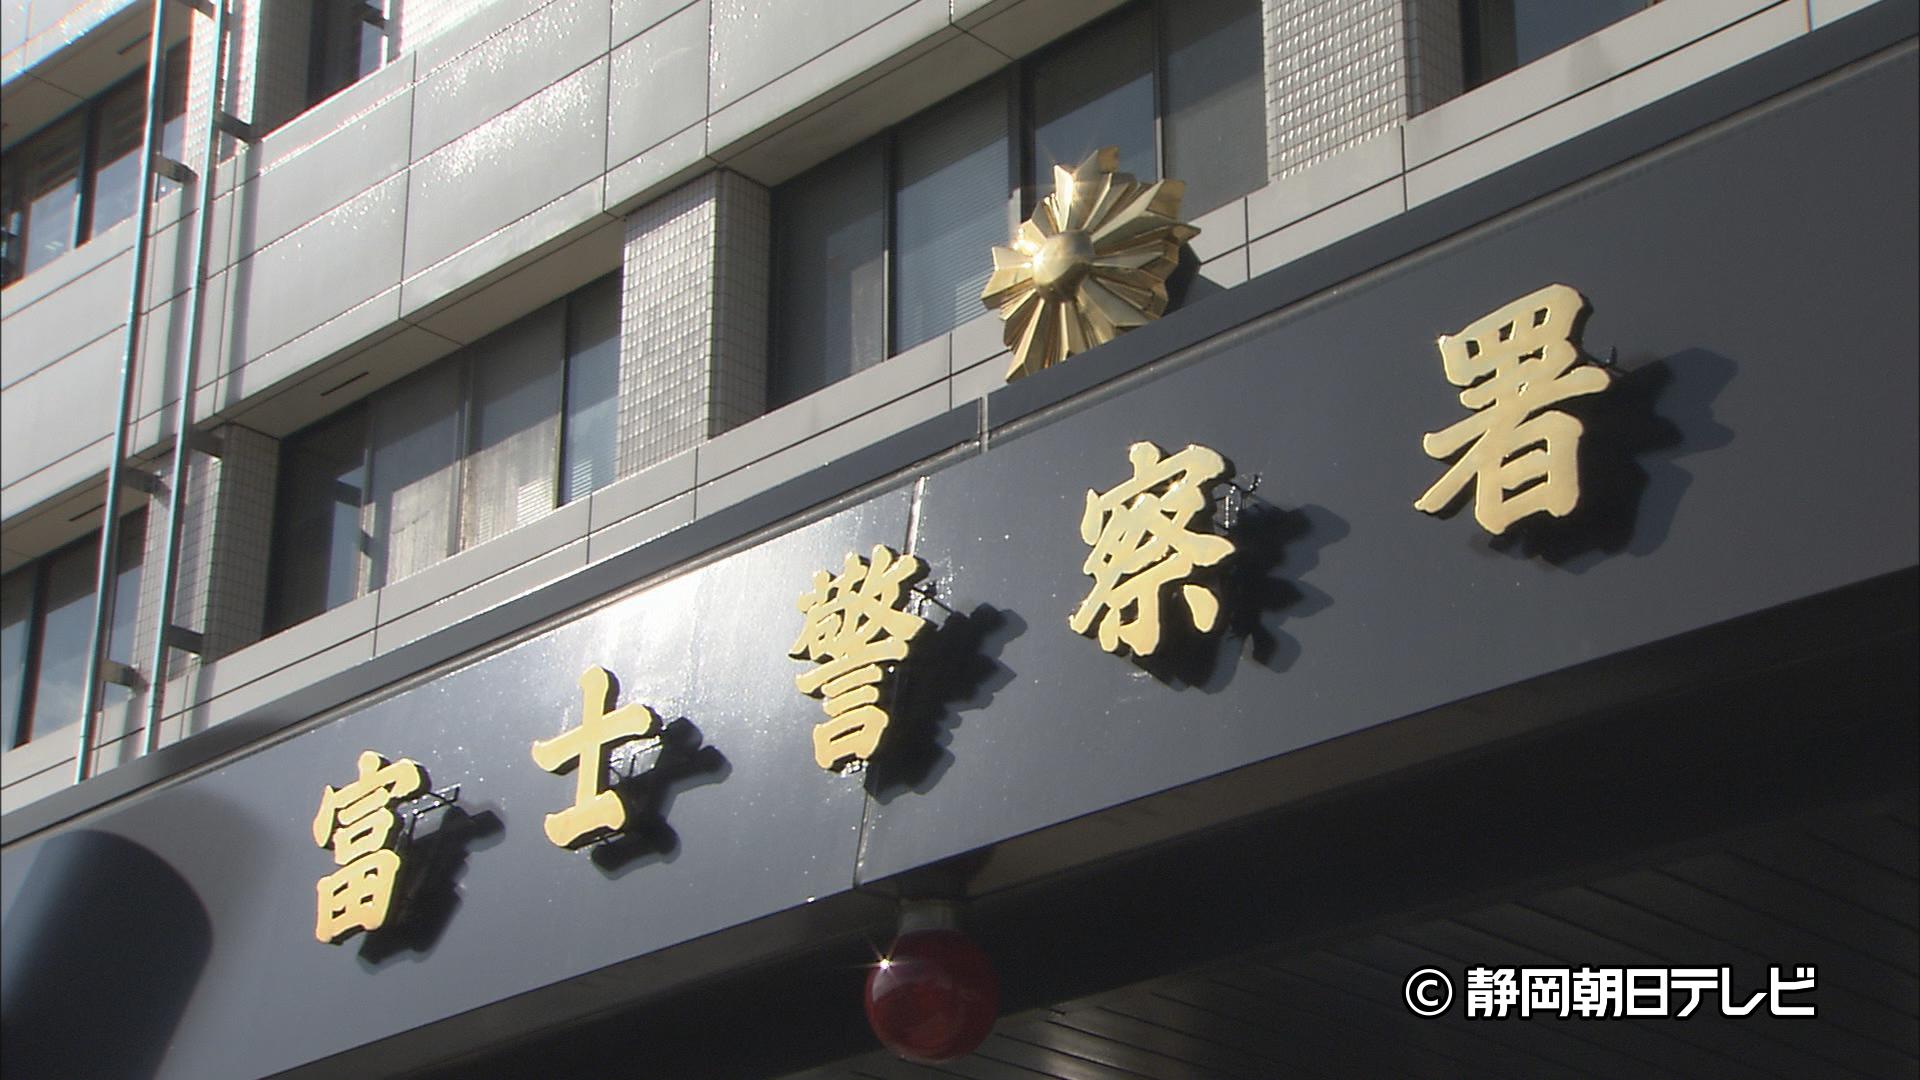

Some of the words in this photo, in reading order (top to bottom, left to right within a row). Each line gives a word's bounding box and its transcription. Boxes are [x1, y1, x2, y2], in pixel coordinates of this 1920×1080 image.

[313, 284, 1611, 945] 富士警察署
